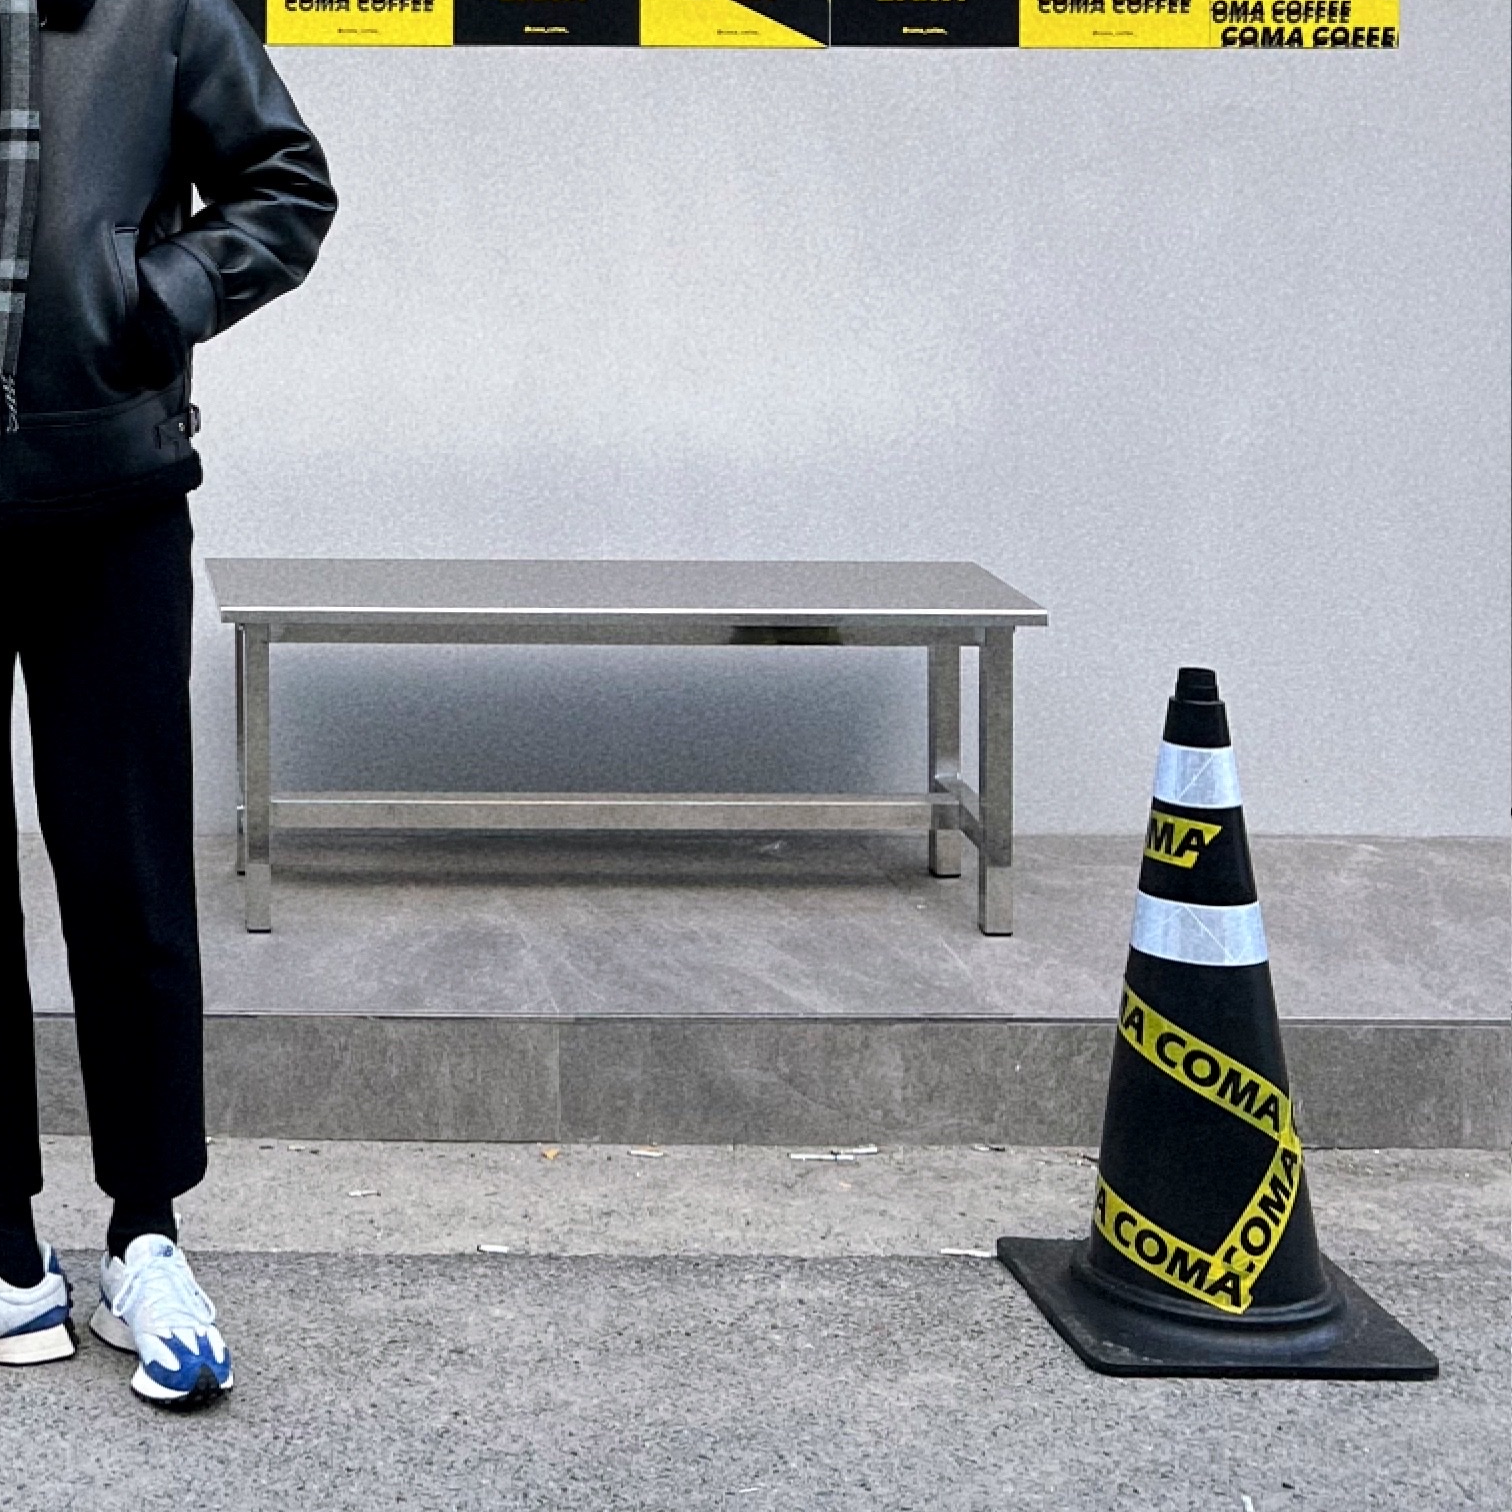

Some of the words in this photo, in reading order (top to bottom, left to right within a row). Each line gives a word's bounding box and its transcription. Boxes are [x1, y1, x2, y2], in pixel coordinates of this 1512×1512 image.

[1211, 0, 1265, 23] OMA
[1272, 0, 1352, 23] COFFEE
[1147, 817, 1205, 859] MA
[1155, 1032, 1280, 1133] COMA
[1114, 1211, 1241, 1308] COMA
